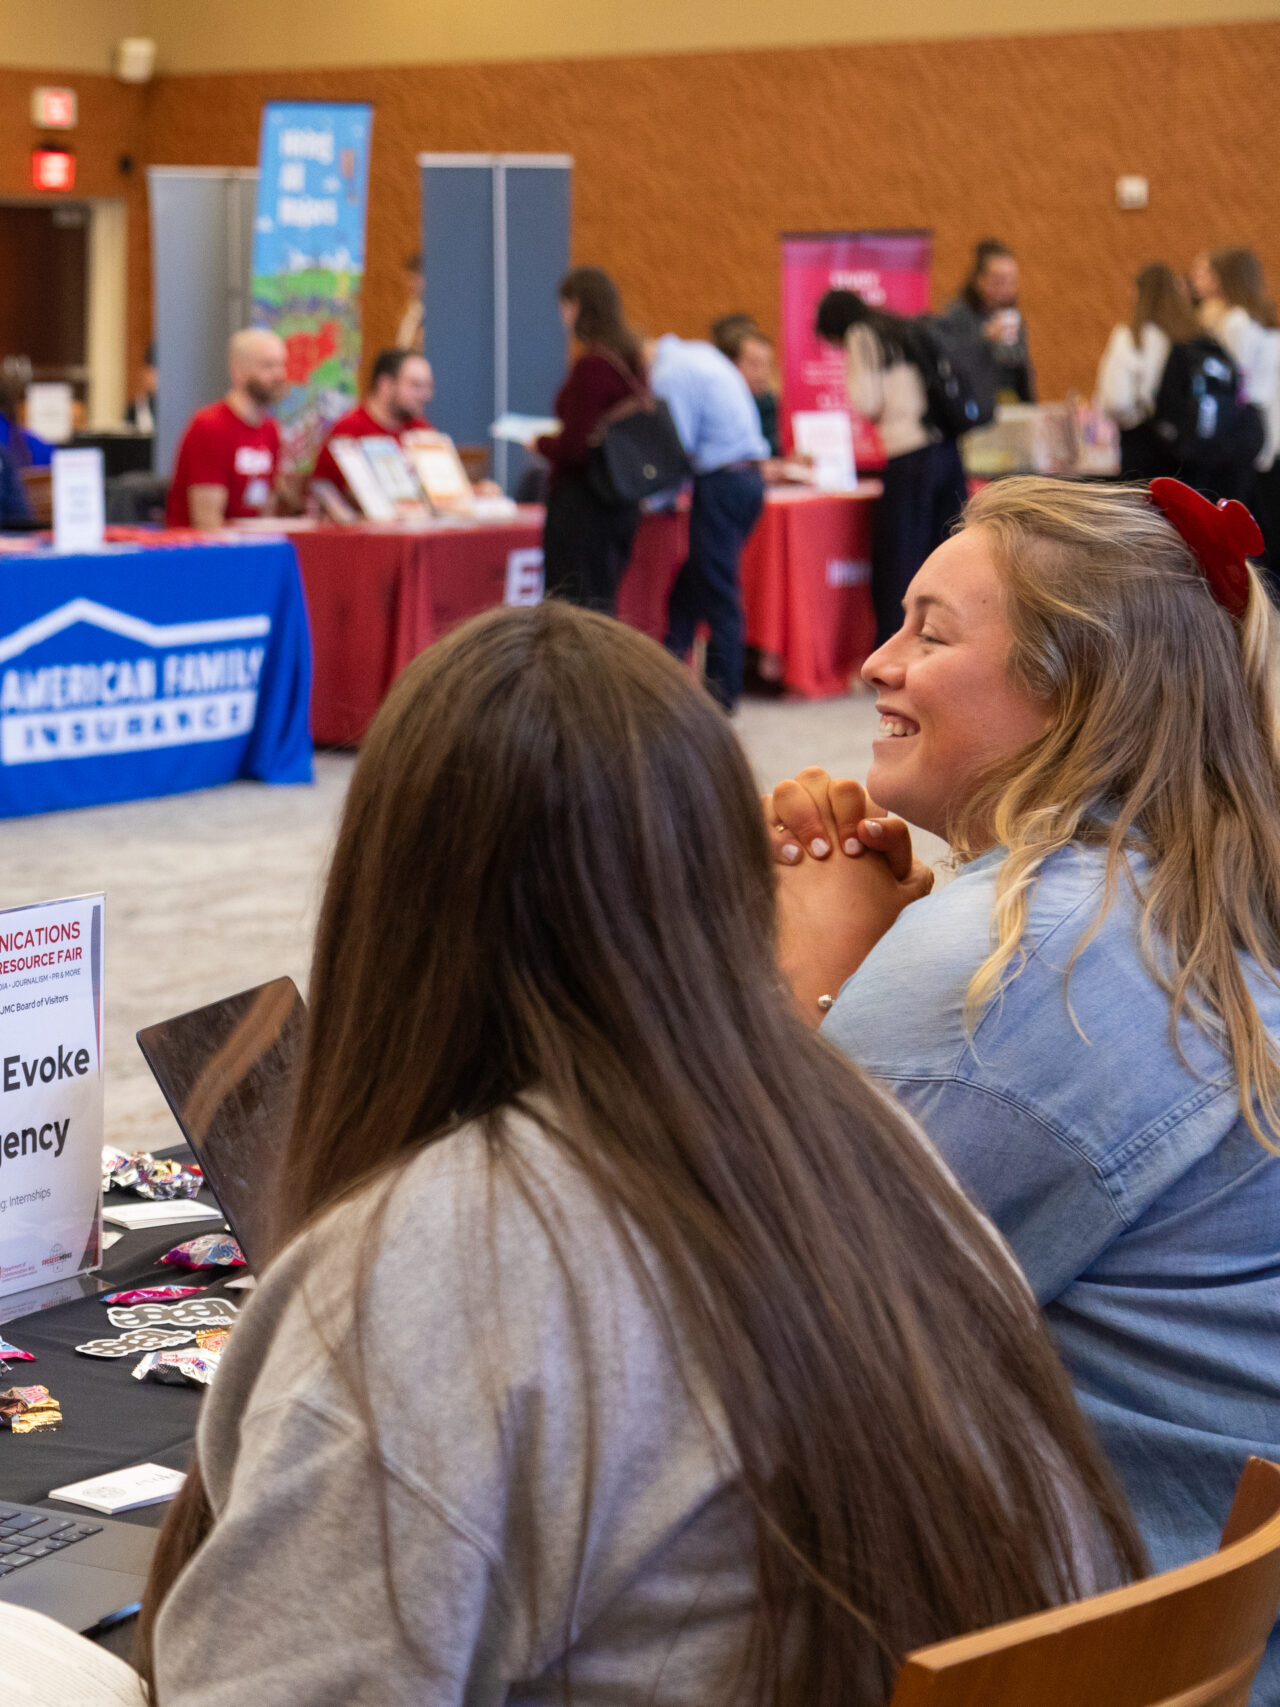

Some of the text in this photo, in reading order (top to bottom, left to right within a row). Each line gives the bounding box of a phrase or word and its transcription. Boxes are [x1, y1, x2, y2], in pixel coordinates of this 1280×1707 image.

[0, 645, 265, 712] AMERICAN FAMILY
[23, 704, 241, 749] INSURANCE
[57, 946, 83, 964] FAIR
[12, 975, 49, 989] JOURNALISM
[51, 972, 60, 981] PR
[65, 967, 81, 978] MORE
[16, 1000, 36, 1012] Board
[36, 998, 45, 1008] of
[44, 993, 69, 1006] Visitors
[3, 1044, 90, 1093] Evoke
[9, 1187, 52, 1207] Internships
